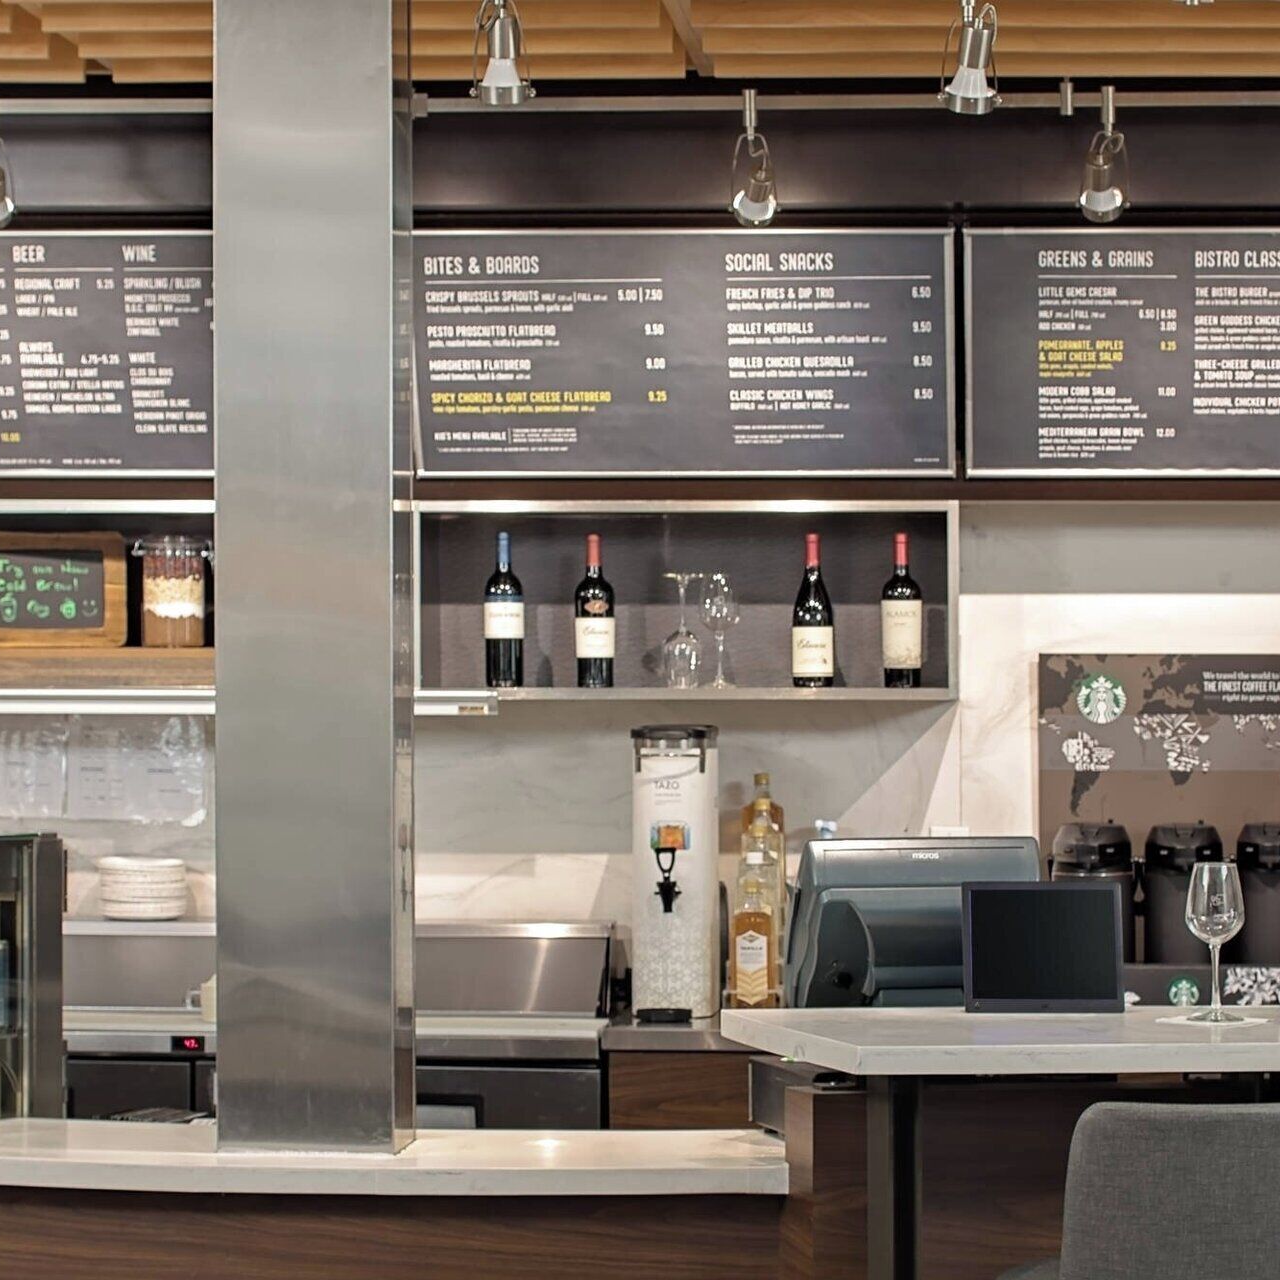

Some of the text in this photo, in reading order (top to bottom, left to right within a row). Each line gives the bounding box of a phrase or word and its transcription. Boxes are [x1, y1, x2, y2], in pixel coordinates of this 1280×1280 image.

[12, 245, 45, 263] BEER
[122, 245, 156, 262] WINE
[1038, 250, 1154, 268] GREENS & GRAINS
[1195, 251, 1239, 268] BISTRO
[424, 256, 540, 275] BITES & BOARDS
[725, 253, 834, 272] SOCIAL SNACKS
[14, 278, 80, 290] REGIONAL CRAFT
[425, 290, 455, 303] CRISPY
[457, 290, 500, 303] BRUSSELS
[502, 290, 539, 303] SPROUTS
[726, 286, 759, 300] FRENCH
[761, 286, 785, 300] FRIES
[787, 286, 795, 300] &
[798, 286, 813, 300] DIP
[815, 286, 835, 300] TRIO
[1038, 286, 1117, 297] LITTLE GEMS CAESAR
[1195, 287, 1209, 298] THE
[1211, 287, 1237, 298] BISTRO
[1239, 287, 1268, 298] BURGER
[1194, 315, 1218, 326] GREEN
[1220, 315, 1253, 326] GODDESS
[427, 324, 556, 337] PESTO PROSCIUTTO FLATBREAD
[728, 321, 932, 335] SKILLET MEATBALLS 9.50
[1038, 340, 1124, 351] POMEGRANATE, APPLES
[729, 356, 854, 369] GRILLED CHICKEN QUESADILLA
[1039, 352, 1124, 362] & GOAT CHEESE SALAD
[429, 358, 481, 371] MARGHERITA
[484, 358, 531, 371] FLATBREAD
[1194, 359, 1249, 369] THREE-CHEESE
[1250, 359, 1280, 369] GRILLED
[1194, 371, 1254, 380] & TOMATO SOUP
[431, 391, 612, 404] SPICY CHORIZO & GOAT CHEESE FLATBREAD
[730, 388, 834, 401] CLASSIC CHICKEN WINGS
[1038, 386, 1068, 396] MODERN
[1070, 386, 1090, 396] COBB
[1092, 386, 1116, 396] SALAD
[1193, 397, 1232, 406] INDIVIDUAL
[1234, 397, 1266, 406] CHICKEN
[1038, 428, 1175, 438] MEDITERRANEAN GRAIN BOWL 12.00
[1203, 671, 1215, 680] We
[1216, 671, 1237, 680] travel
[1238, 671, 1249, 680] the
[1251, 671, 1271, 680] world
[1204, 681, 1217, 692] THE
[1218, 681, 1241, 692] FINEST
[1242, 681, 1267, 692] COFFEE
